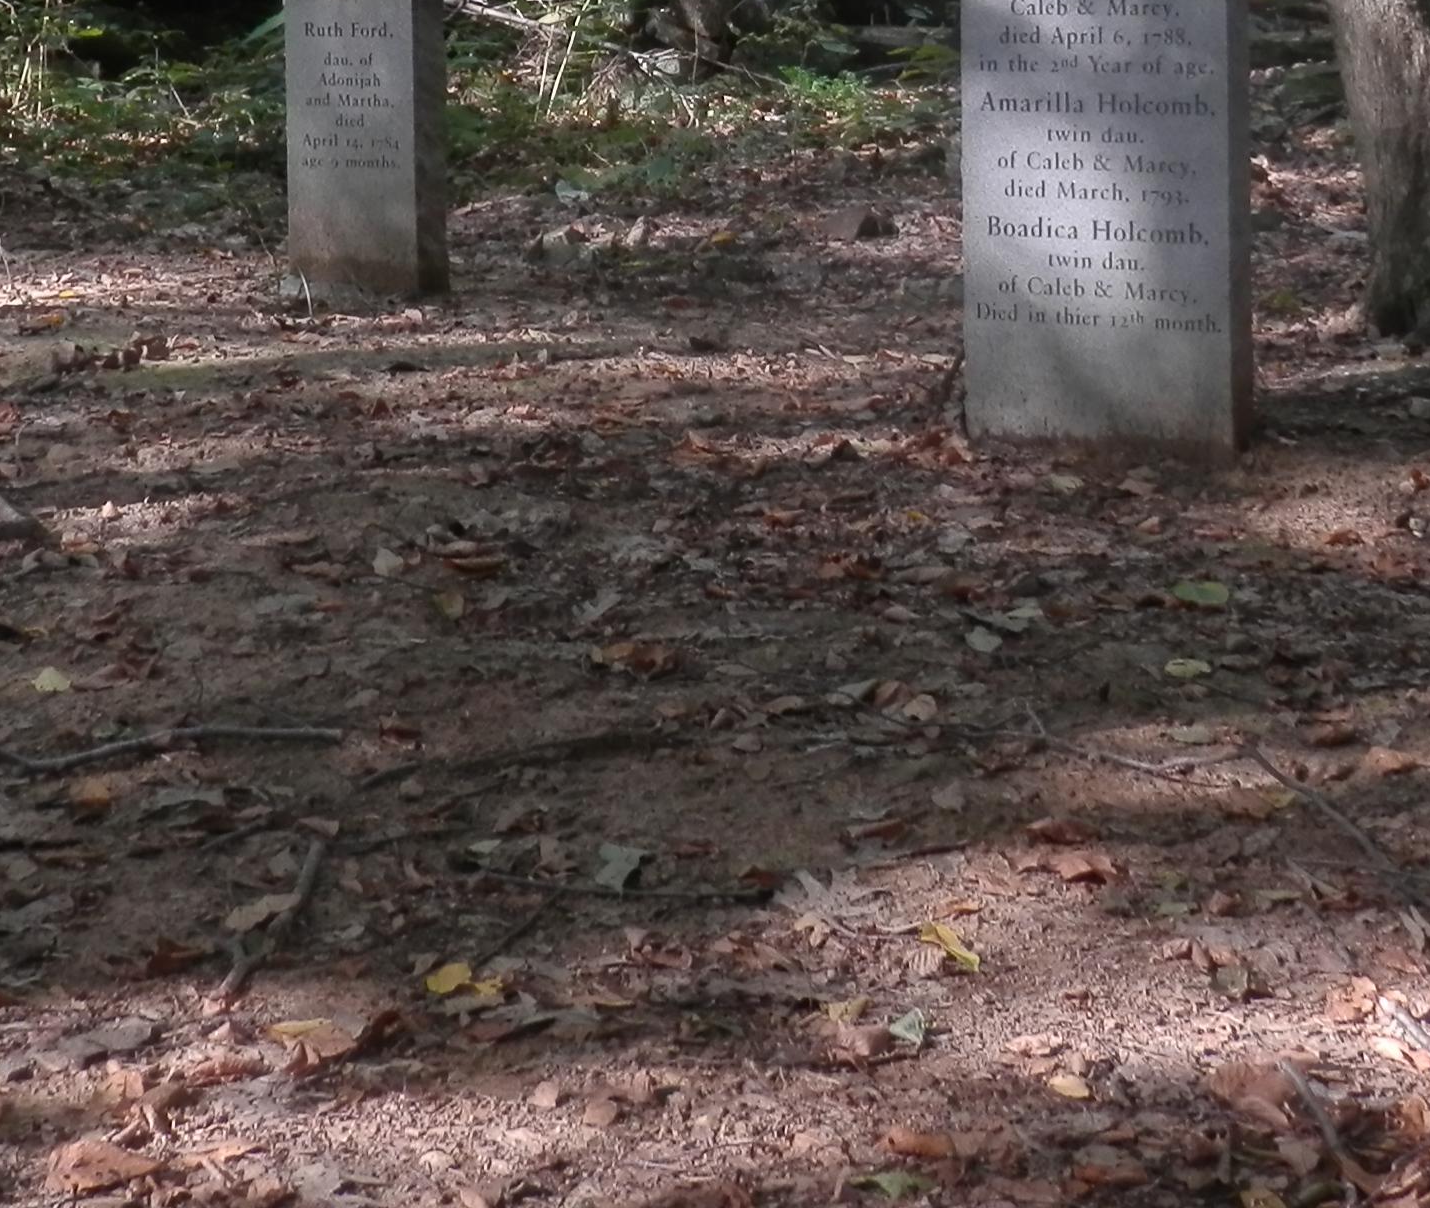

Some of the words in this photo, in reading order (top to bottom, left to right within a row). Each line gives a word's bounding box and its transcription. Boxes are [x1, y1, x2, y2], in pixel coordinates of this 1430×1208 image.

[304, 22, 342, 37] Ruth
[999, 25, 1040, 44] died
[1051, 26, 1102, 49] April
[360, 52, 372, 65] of
[979, 54, 997, 72] in
[1009, 54, 1039, 73] the
[1051, 55, 1078, 73] 2nd
[1088, 55, 1132, 73] Year
[1142, 55, 1163, 74] of
[320, 73, 380, 89] Adonijah
[306, 92, 330, 106] and
[980, 91, 1083, 113] Amarilla
[336, 114, 364, 127] died
[304, 133, 338, 150] April
[1047, 125, 1091, 142] twin
[302, 158, 321, 169] age
[997, 151, 1017, 169] of
[1027, 152, 1083, 170] Caleb
[1093, 154, 1112, 171] &
[1004, 179, 1045, 198] died
[987, 216, 1078, 239] Boadica
[1048, 250, 1091, 269] twin
[998, 275, 1018, 293] of
[1027, 276, 1085, 296] Caleb
[1094, 280, 1112, 298] &
[977, 302, 1018, 322] Died
[1028, 304, 1045, 323] in
[1056, 307, 1100, 326] thier
[1111, 311, 1144, 328] 12th
